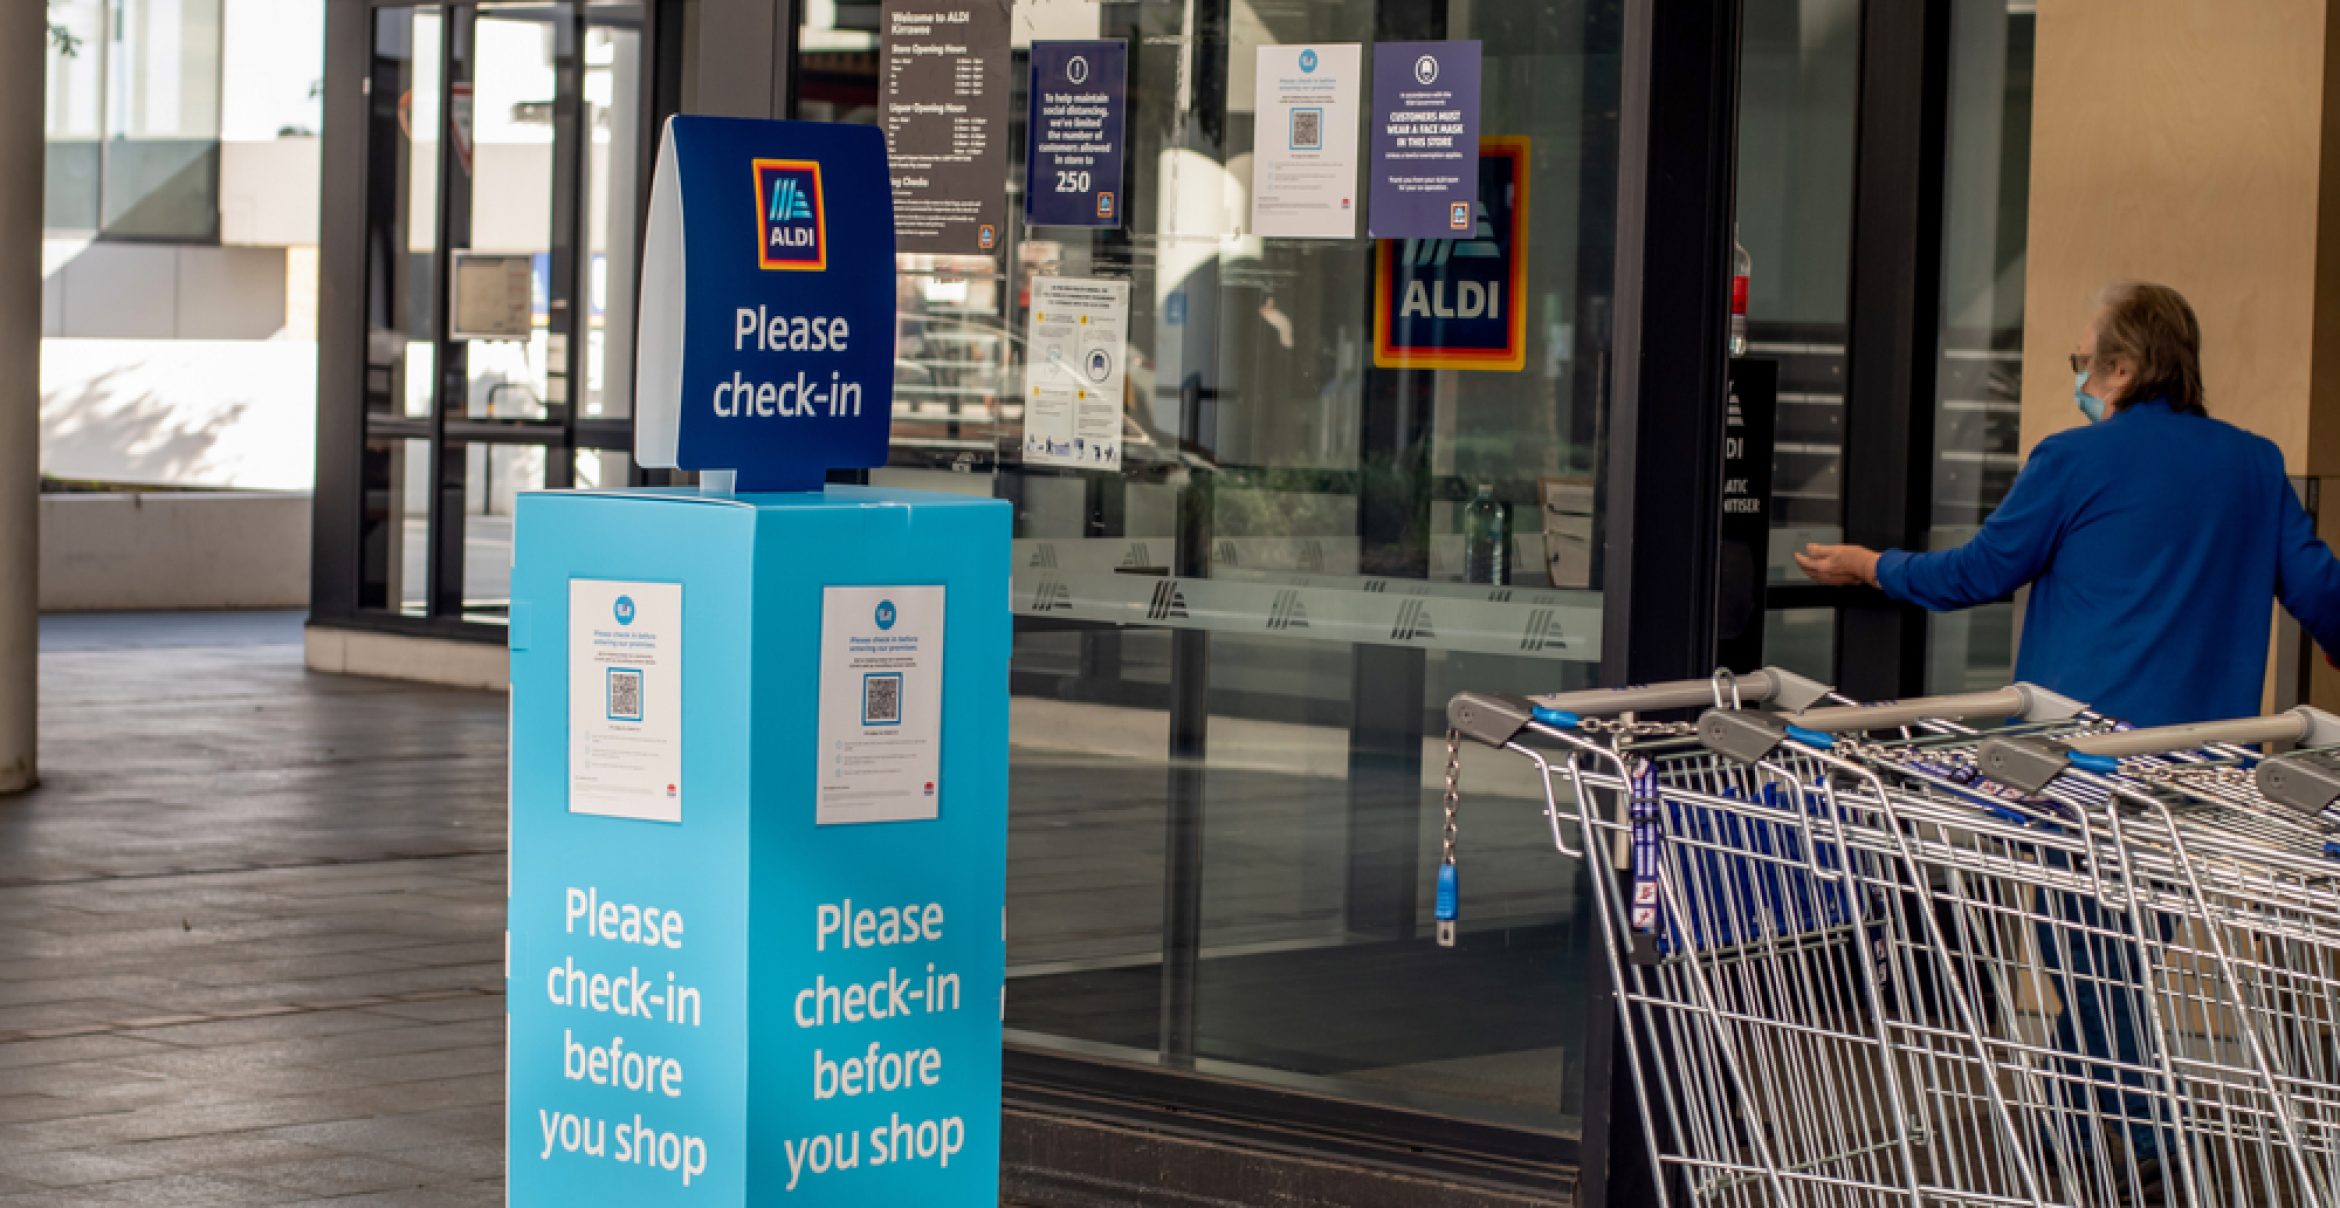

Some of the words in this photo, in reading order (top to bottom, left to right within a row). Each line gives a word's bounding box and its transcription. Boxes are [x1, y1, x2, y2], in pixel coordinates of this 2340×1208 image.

[891, 11, 934, 24] Welcome
[935, 12, 946, 24] to
[947, 11, 969, 24] ALDI
[912, 44, 943, 56] Opening
[944, 44, 967, 55] Hours
[1044, 93, 1054, 104] To
[1055, 93, 1072, 106] help
[1073, 92, 1109, 104] maintain
[912, 103, 943, 115] Opening
[944, 103, 967, 113] Hours
[1043, 105, 1065, 116] social
[1390, 111, 1438, 122] CUSTOMERS
[1438, 110, 1461, 122] MUST
[1073, 117, 1102, 128] limited
[1387, 123, 1410, 134] WEAR
[1411, 123, 1418, 134] A
[1419, 123, 1438, 134] FACE
[1439, 123, 1463, 134] MASK
[1047, 130, 1061, 141] the
[1061, 130, 1094, 141] number
[1095, 130, 1104, 141] of
[1396, 136, 1407, 148] IN
[1408, 136, 1426, 148] THIS
[1426, 136, 1453, 148] STORE
[1039, 143, 1079, 153] customers
[1080, 142, 1111, 153] allowed
[1055, 154, 1064, 165] in
[1064, 155, 1084, 165] store
[1085, 155, 1094, 165] to
[902, 176, 929, 188] Checks
[1055, 171, 1090, 193] 250
[770, 227, 816, 246] ALDI
[1400, 280, 1499, 319] ALDI
[735, 304, 849, 351] Please
[713, 371, 862, 417] check-in
[565, 887, 684, 949] Please
[816, 899, 944, 952] Please
[547, 956, 701, 1027] check-in
[794, 963, 961, 1027] check-in
[564, 1028, 682, 1097] before
[813, 1042, 941, 1100] before
[539, 1108, 605, 1159] you
[614, 1113, 708, 1187] shop
[784, 1129, 860, 1192] you
[868, 1112, 965, 1168] shop
